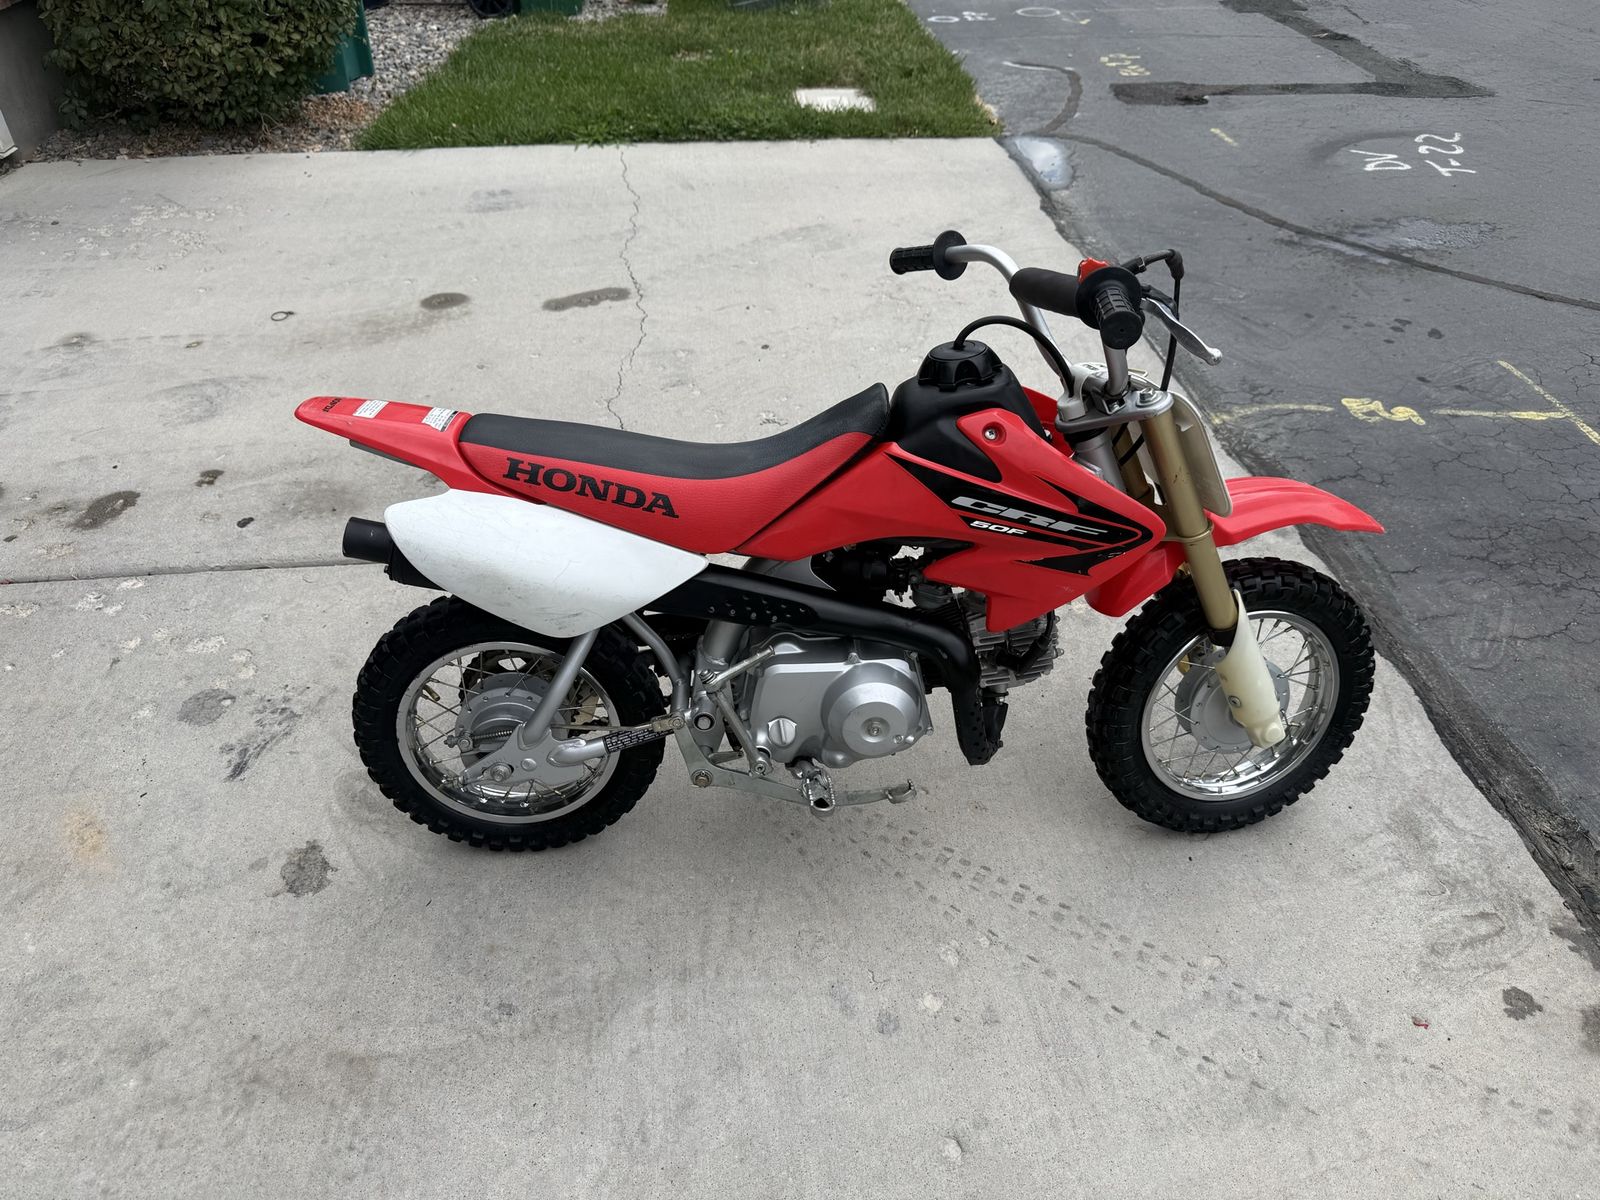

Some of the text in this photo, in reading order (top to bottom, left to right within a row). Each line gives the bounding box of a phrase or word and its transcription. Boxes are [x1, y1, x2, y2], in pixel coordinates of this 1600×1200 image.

[502, 457, 680, 519] HONDA
[951, 496, 1108, 536] CRF
[970, 520, 1028, 535] 50F
